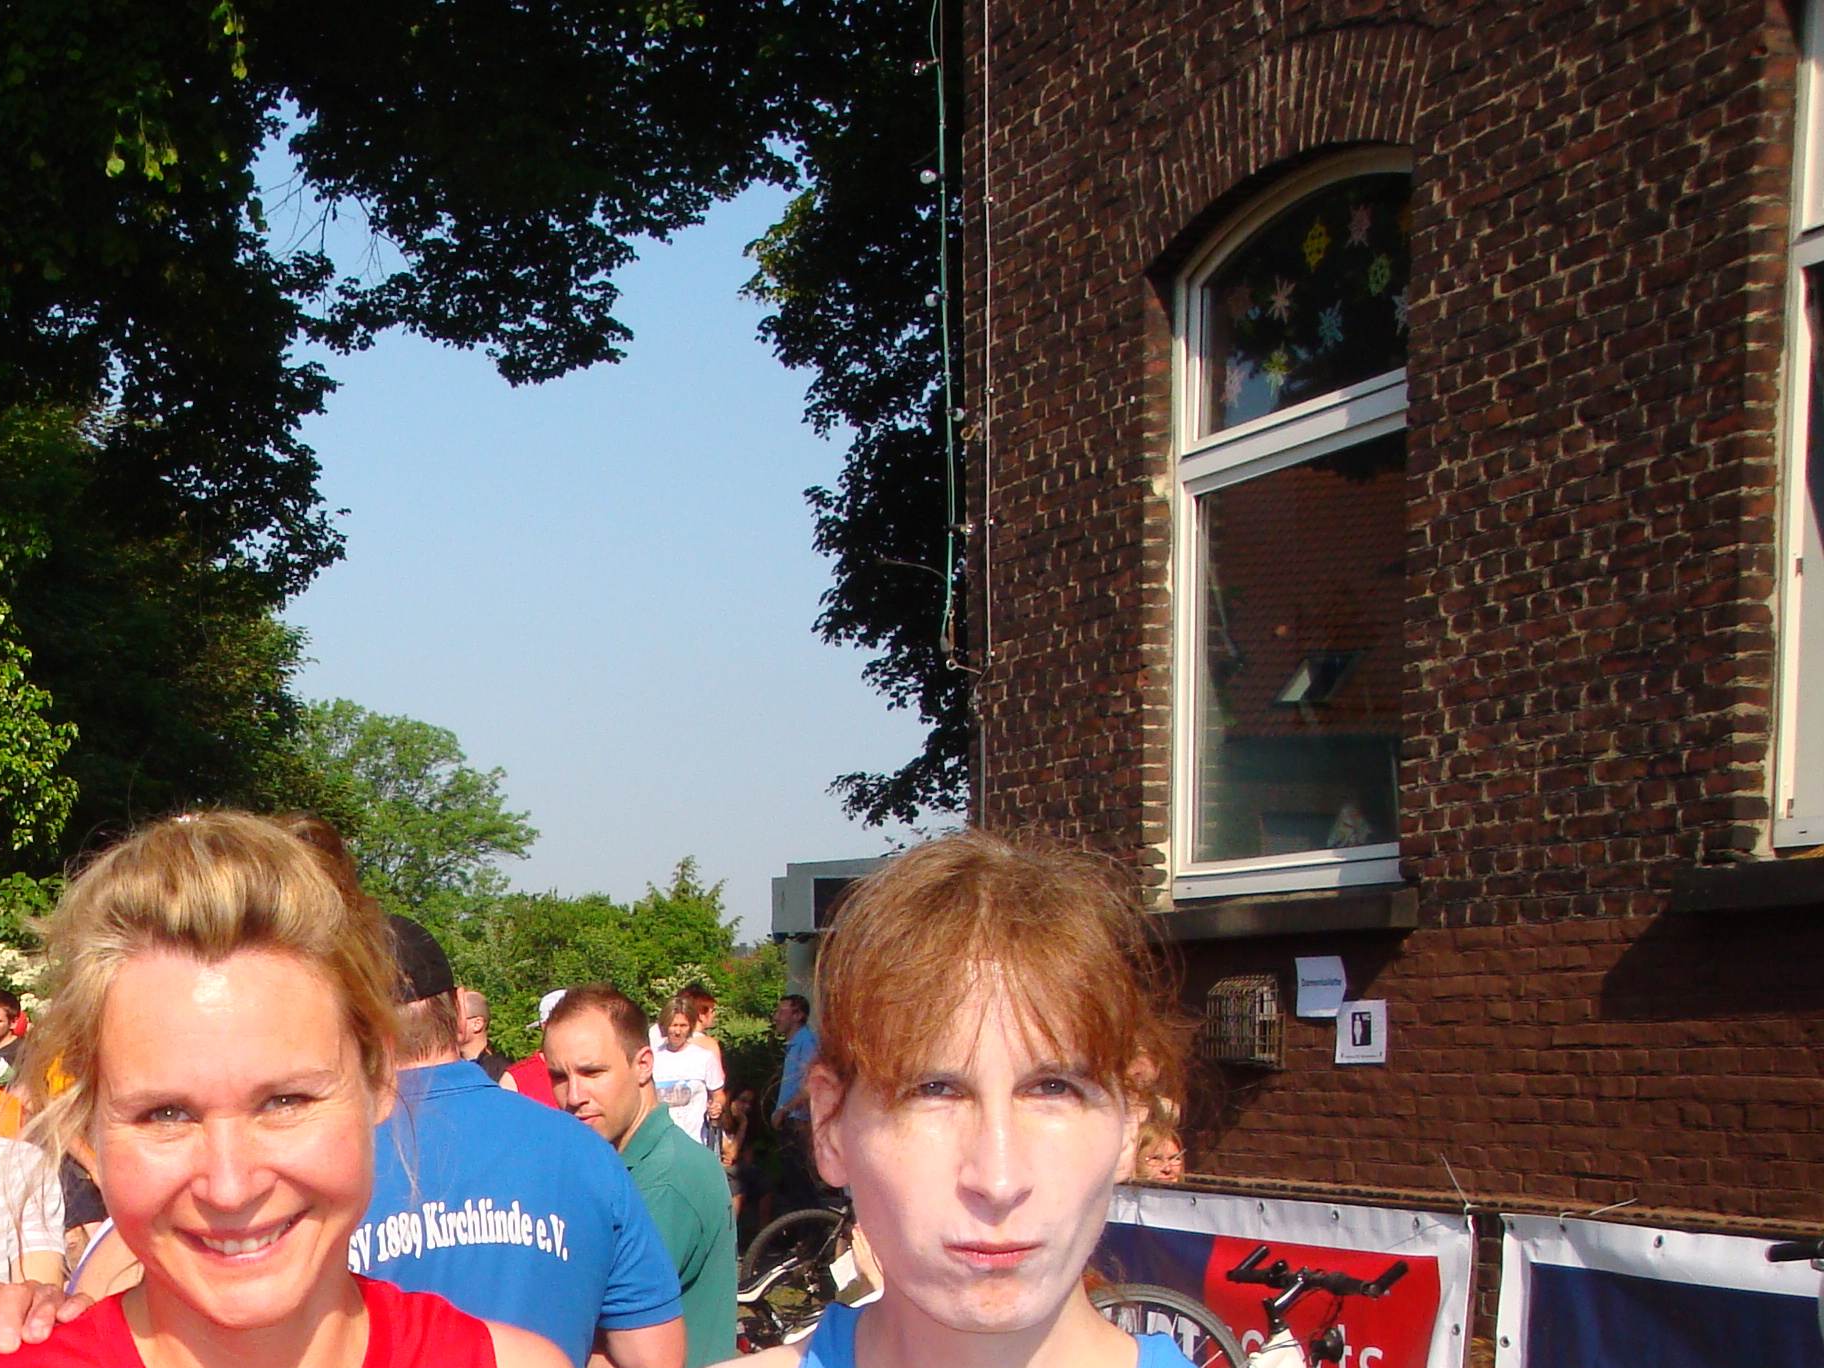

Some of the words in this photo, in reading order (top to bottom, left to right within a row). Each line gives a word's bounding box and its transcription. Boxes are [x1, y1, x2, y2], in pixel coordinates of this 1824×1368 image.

[376, 1212, 423, 1262] 1889
[422, 1198, 534, 1250] Kirchlinde
[535, 1214, 569, 1262] e.V.
